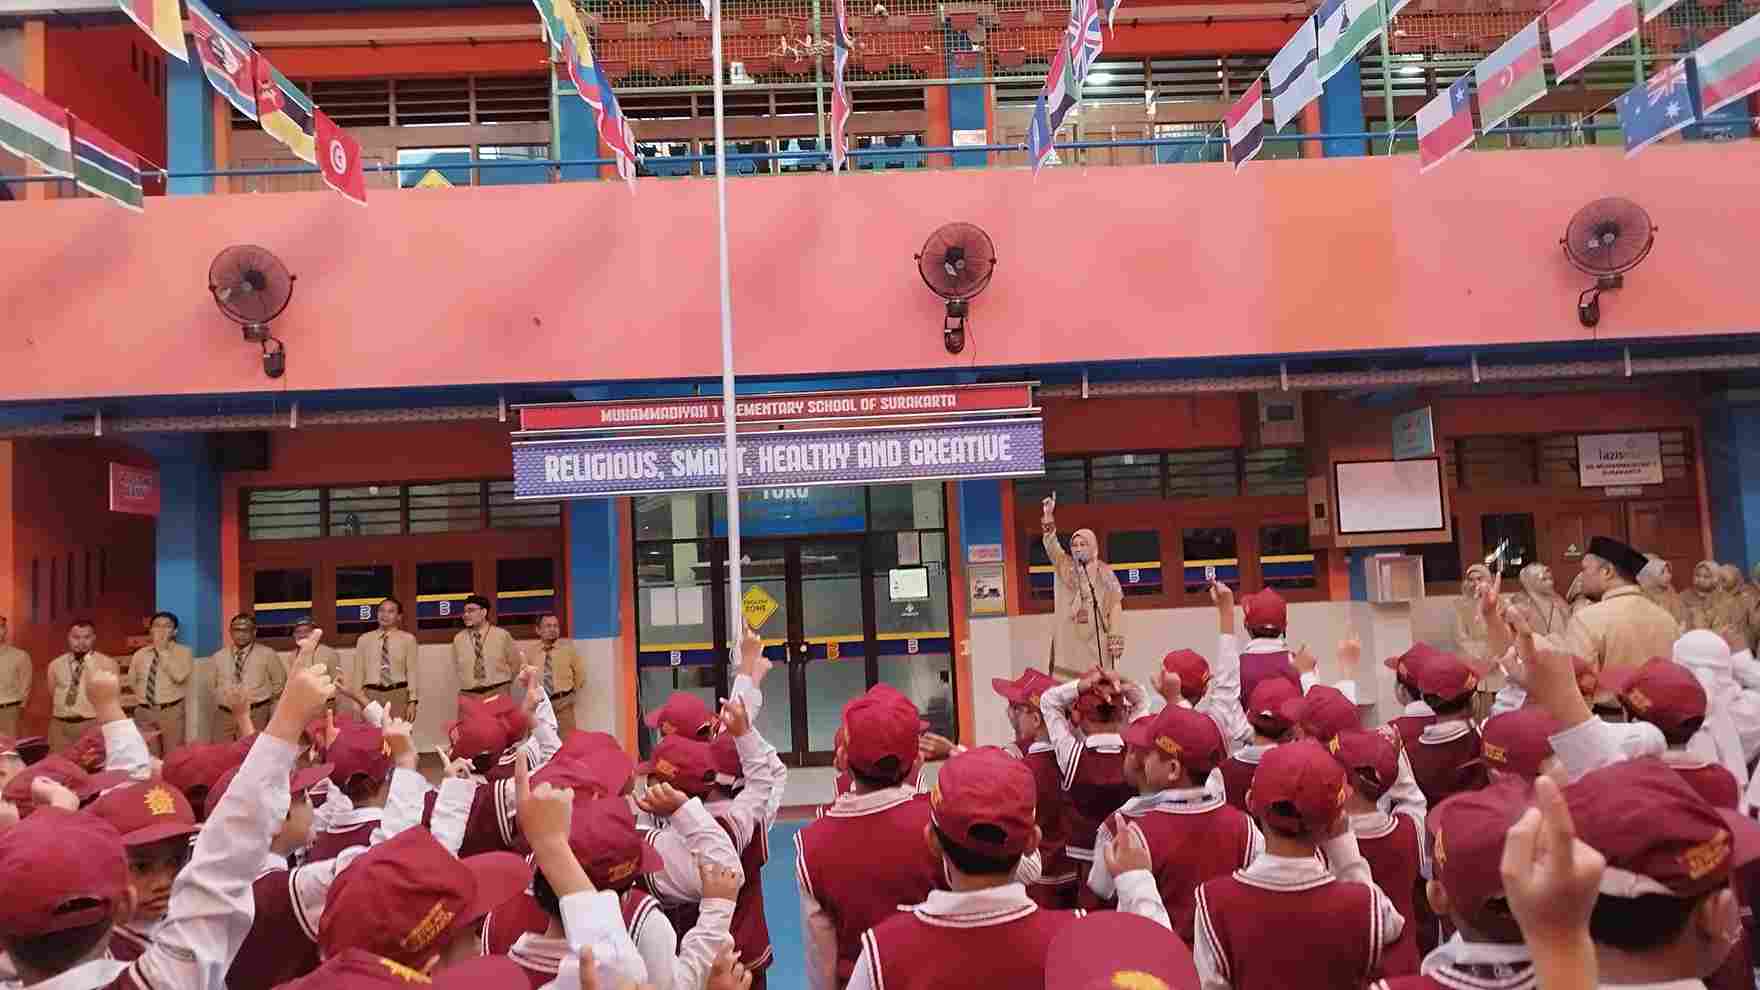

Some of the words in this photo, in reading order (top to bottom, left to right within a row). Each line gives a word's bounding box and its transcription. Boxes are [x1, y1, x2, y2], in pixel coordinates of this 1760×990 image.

[601, 405, 706, 422] MUHAMMADIYAH
[711, 405, 719, 418] 1
[807, 400, 857, 413] SCHOOL
[860, 398, 878, 411] OF
[880, 394, 956, 406] SURAKARTA
[544, 452, 665, 482] RELIGIOUS,
[759, 442, 850, 473] HEALTHY
[857, 439, 900, 468] AND
[910, 434, 1012, 466] CREATIVE
